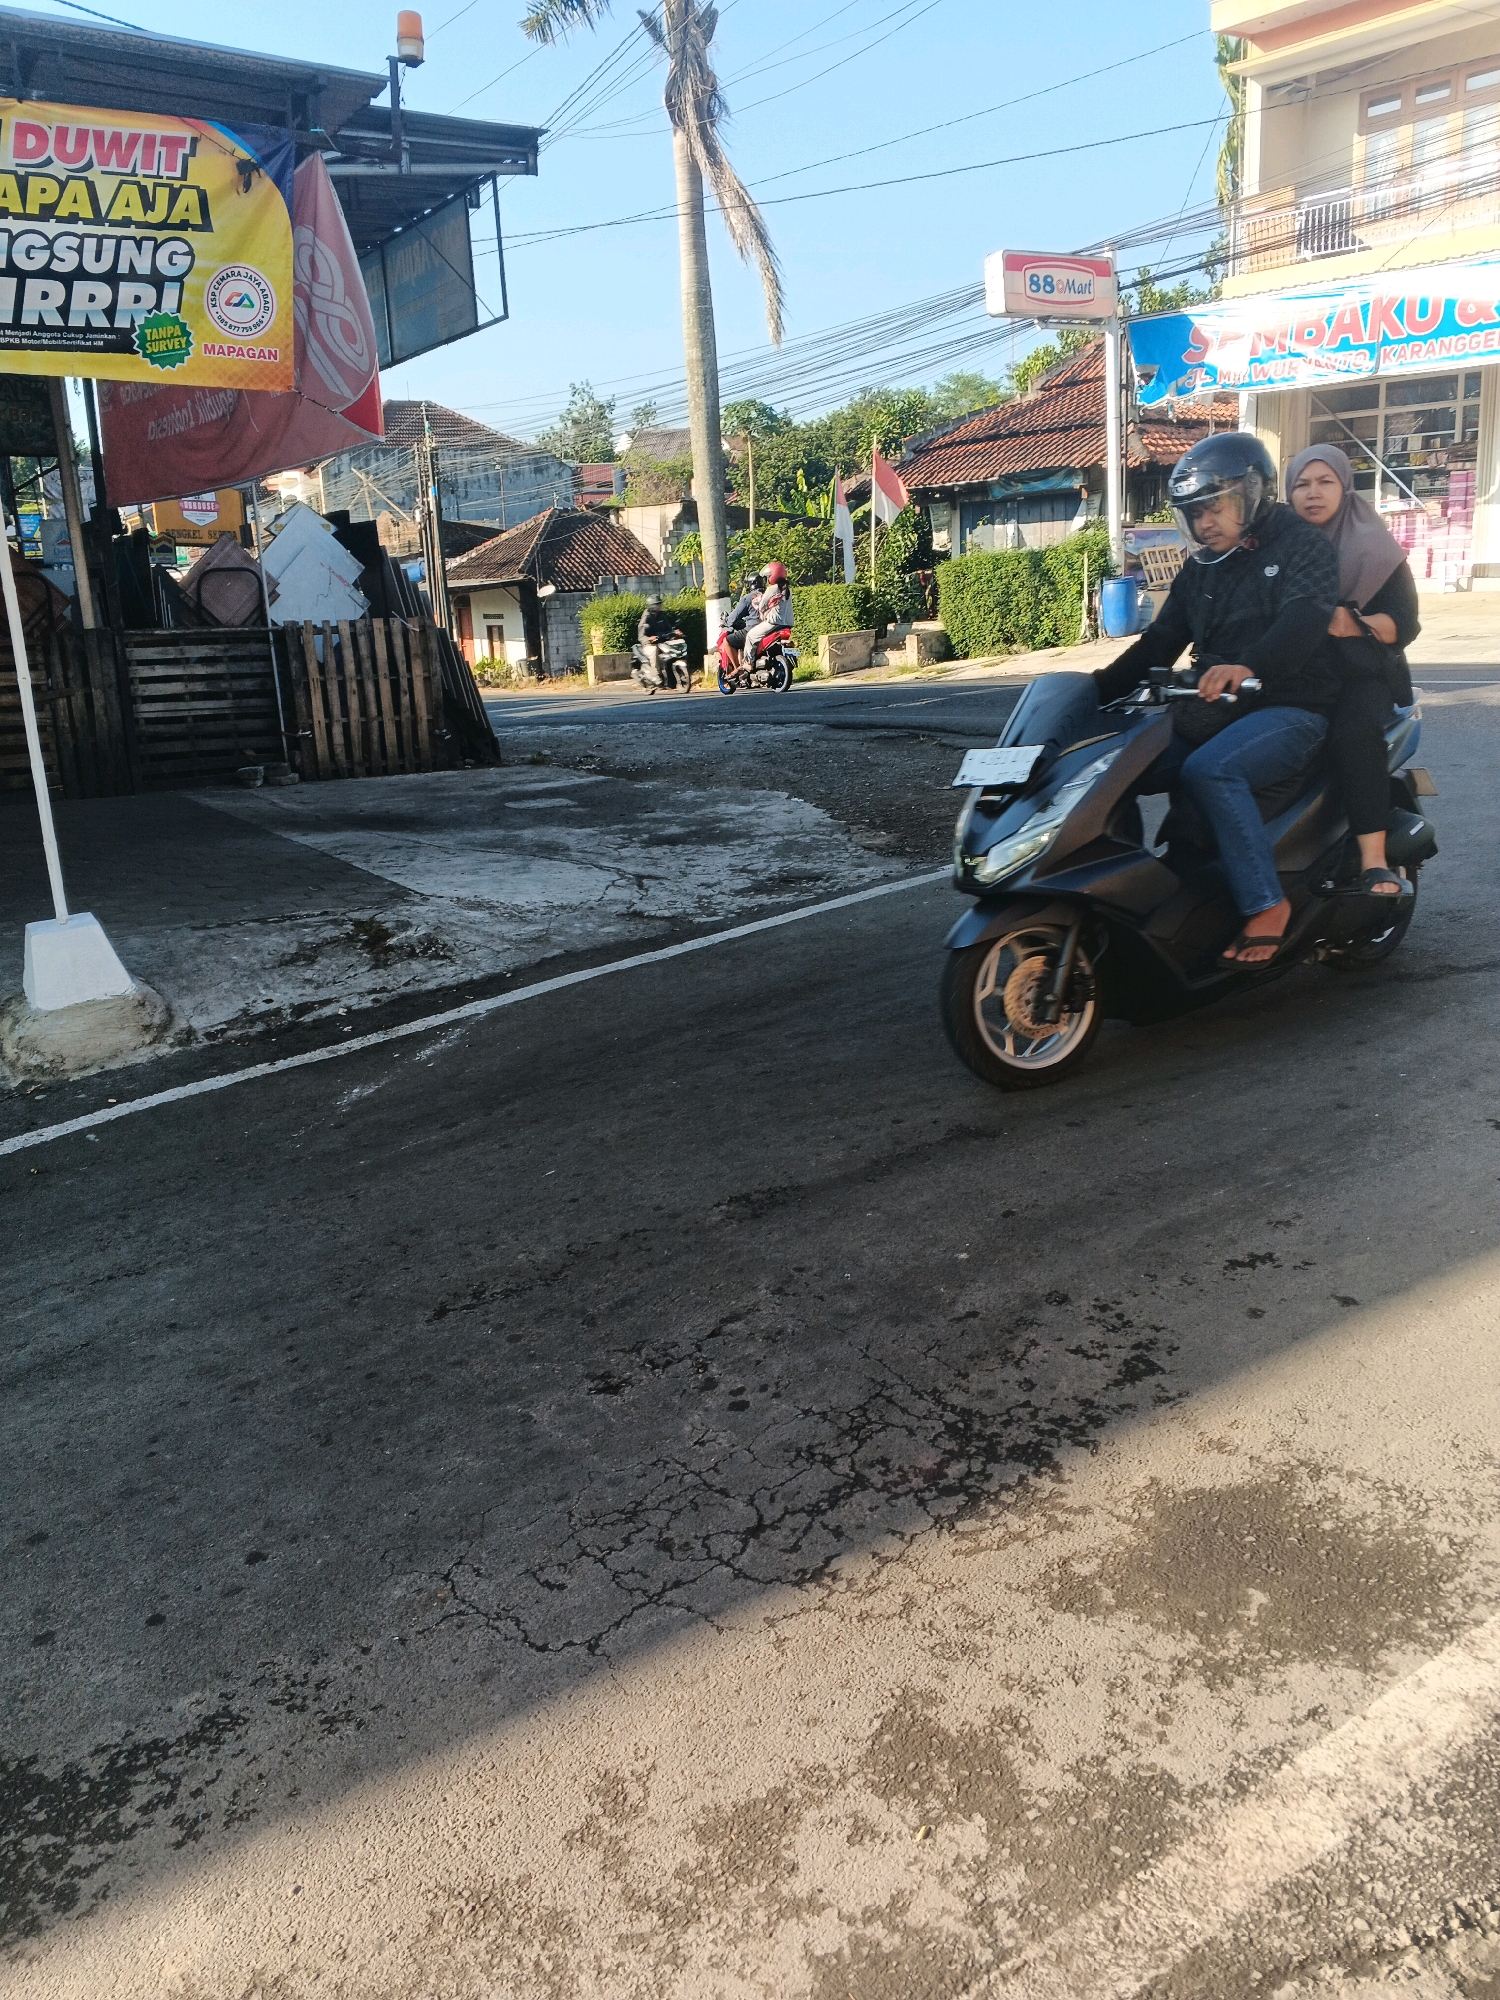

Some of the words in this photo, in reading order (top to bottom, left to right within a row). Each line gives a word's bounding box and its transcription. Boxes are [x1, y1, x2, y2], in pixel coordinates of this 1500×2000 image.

[12, 120, 189, 174] DUWIT
[107, 183, 203, 224] AJA
[0, 232, 192, 277] GSUNG
[213, 270, 243, 291] CEMARA
[243, 272, 262, 289] JAYA
[1029, 273, 1055, 295] 88
[1064, 278, 1092, 295] Mart
[210, 291, 218, 308] KSP
[260, 288, 270, 315] ABADI
[5, 329, 31, 337] Menjadi
[145, 325, 182, 341] TANPA
[1182, 290, 1444, 364] SMBAKU
[146, 337, 187, 353] SURVEY
[204, 343, 278, 361] MAPAGAN
[1382, 329, 1500, 365] KARANGGE
[207, 530, 238, 541] SEPA
